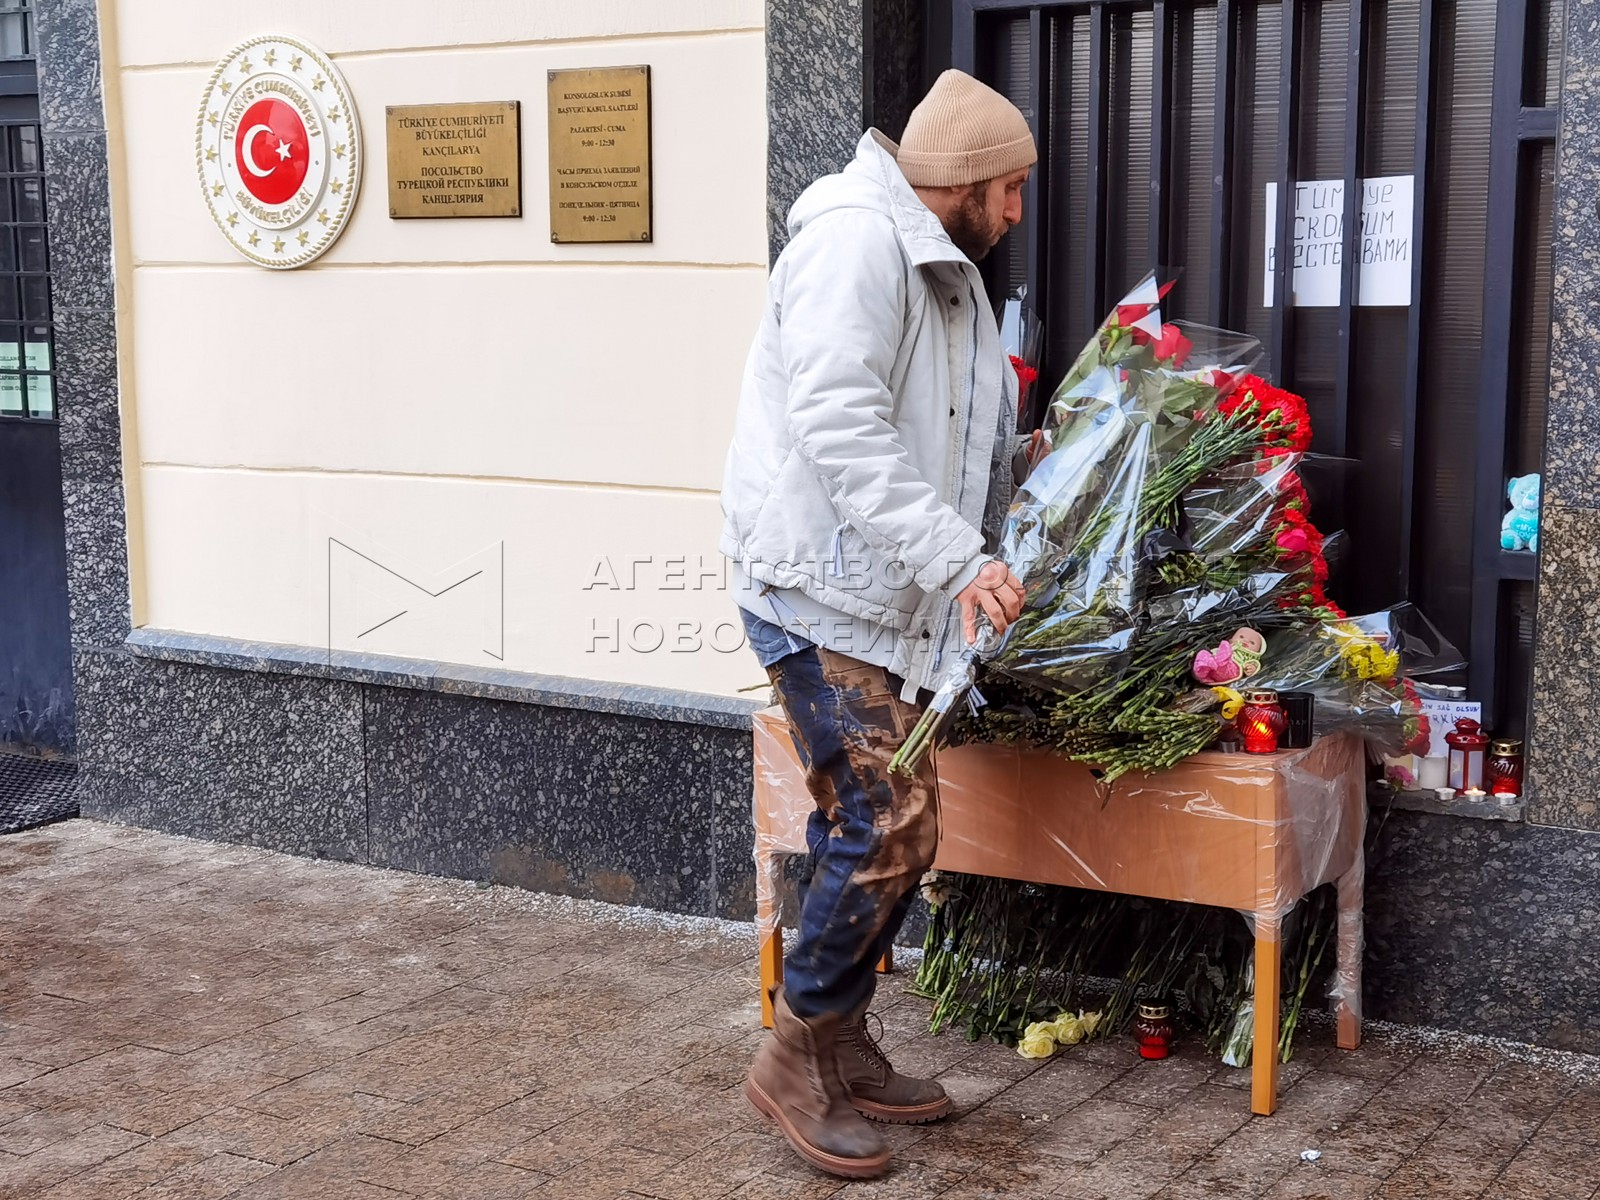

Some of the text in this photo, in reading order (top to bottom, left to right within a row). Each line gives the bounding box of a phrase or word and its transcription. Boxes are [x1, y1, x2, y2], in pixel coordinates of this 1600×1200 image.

[398, 116, 437, 128] TÜRKİYE
[422, 145, 480, 157] KANÇILARYA
[421, 166, 483, 177] ПОСОЛЬСТВО
[397, 178, 509, 190] ТУРЕЦКОЙ РЕСПУБЛИКИ
[422, 194, 484, 205] КАНЦЕЛЯРИЯ
[1362, 237, 1408, 264] ВАМИ
